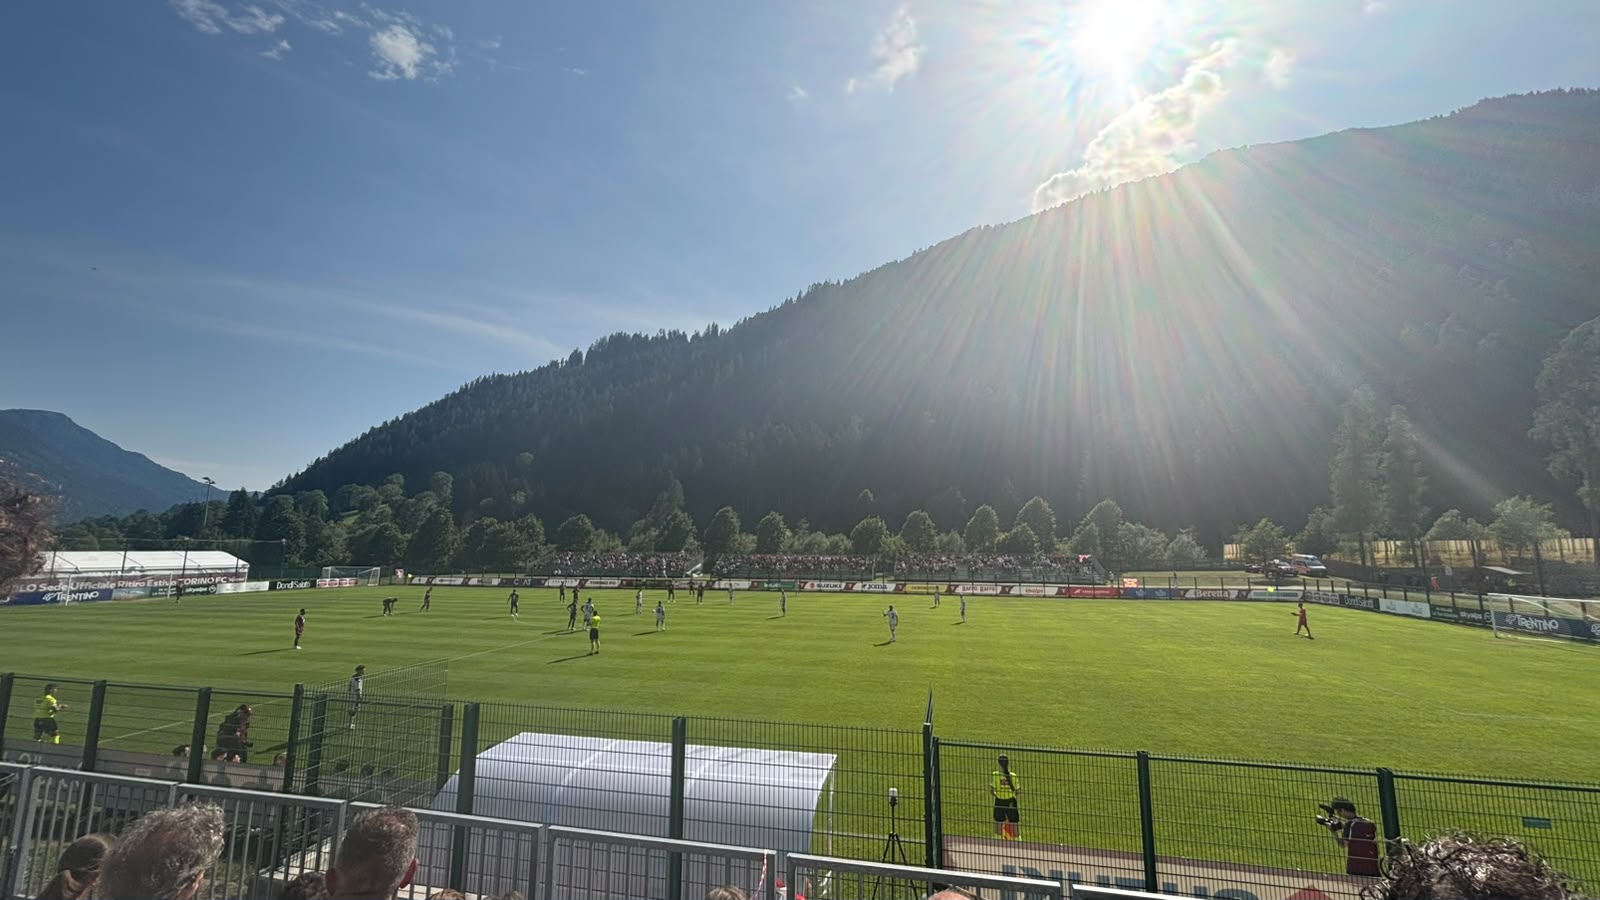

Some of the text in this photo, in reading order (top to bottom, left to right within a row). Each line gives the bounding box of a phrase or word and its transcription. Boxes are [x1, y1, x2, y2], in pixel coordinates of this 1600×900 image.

[38, 581, 68, 592] Sede
[70, 581, 116, 591] Ufficiale
[215, 576, 228, 584] FC
